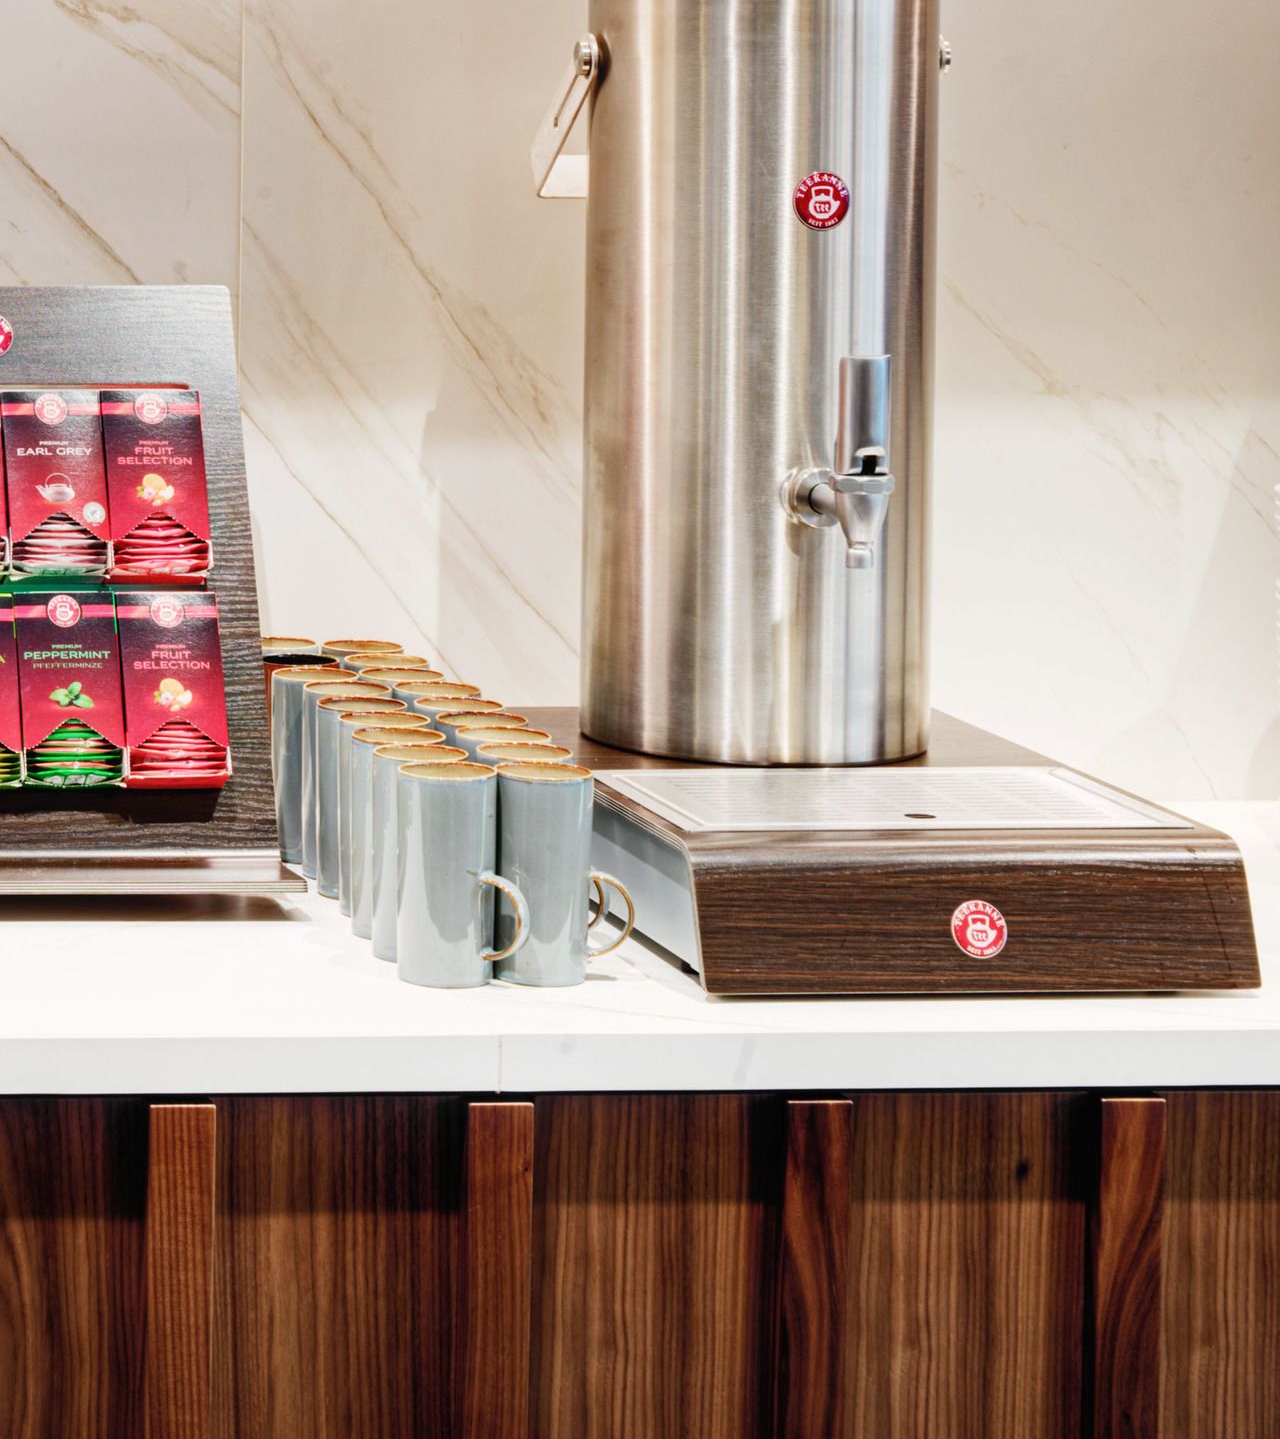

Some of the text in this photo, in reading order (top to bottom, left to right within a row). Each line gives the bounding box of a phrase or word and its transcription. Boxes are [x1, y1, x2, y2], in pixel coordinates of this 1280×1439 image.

[797, 173, 848, 198] TEEKANNE
[16, 447, 93, 456] EARL GREY
[134, 446, 175, 455] FRUIT
[117, 456, 193, 465] SELECTION
[24, 650, 111, 660] PEPPERMINT
[151, 650, 192, 659] FRUIT
[133, 660, 211, 670] SELECTION
[954, 902, 1005, 927] TEEKANNE
